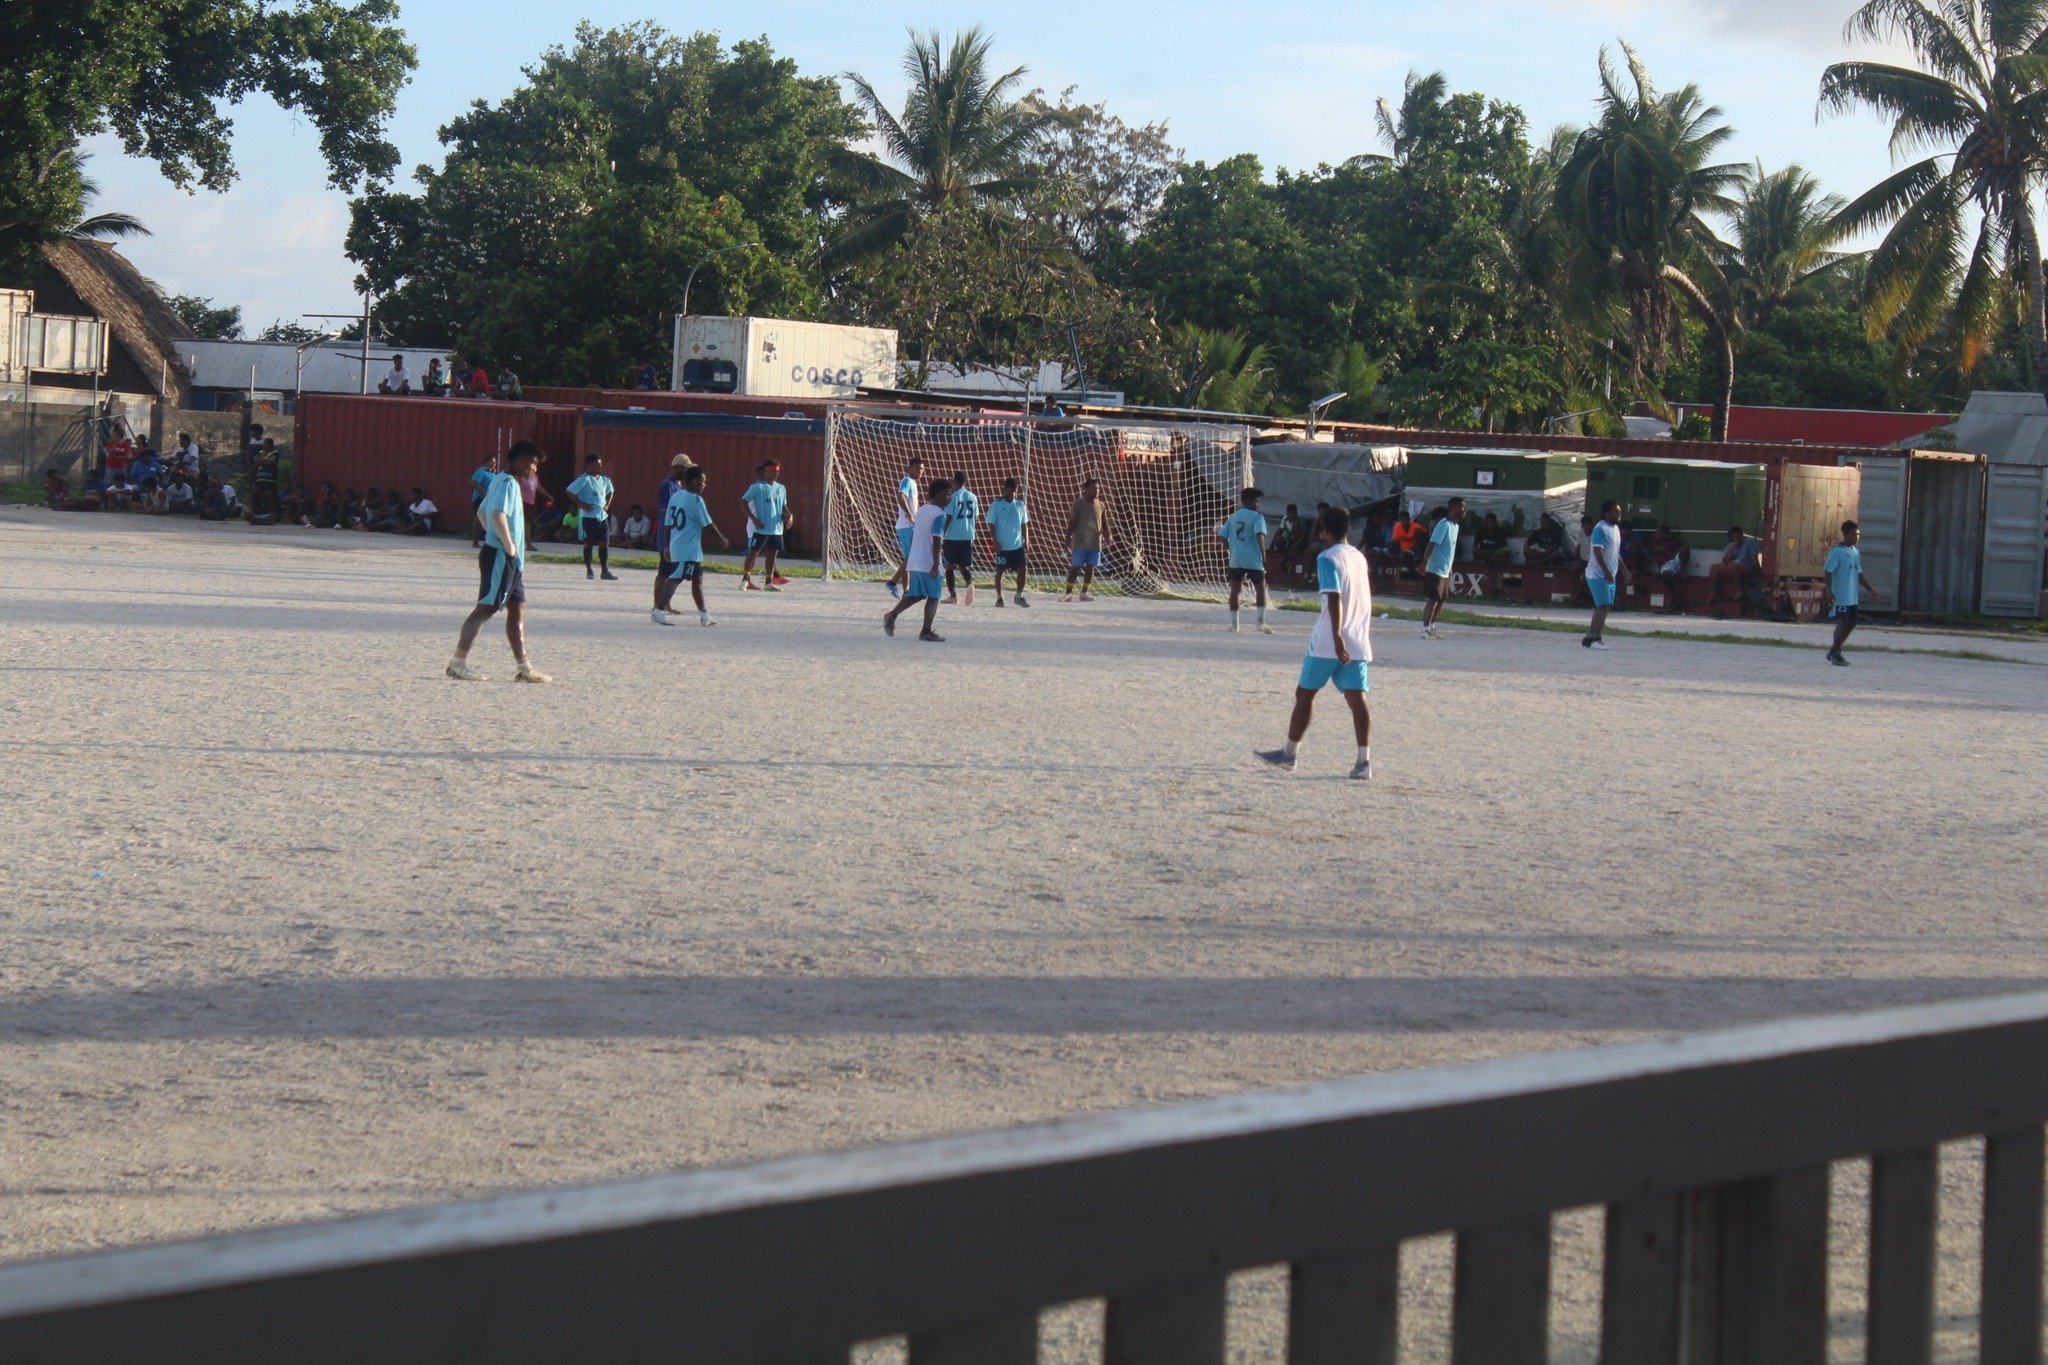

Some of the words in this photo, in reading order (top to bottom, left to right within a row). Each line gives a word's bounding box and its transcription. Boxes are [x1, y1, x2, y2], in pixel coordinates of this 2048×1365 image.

[791, 365, 863, 386] COSCO
[670, 505, 687, 531] 30
[956, 500, 974, 520] 25
[1235, 521, 1246, 542] 2
[1449, 571, 1485, 597] ex
